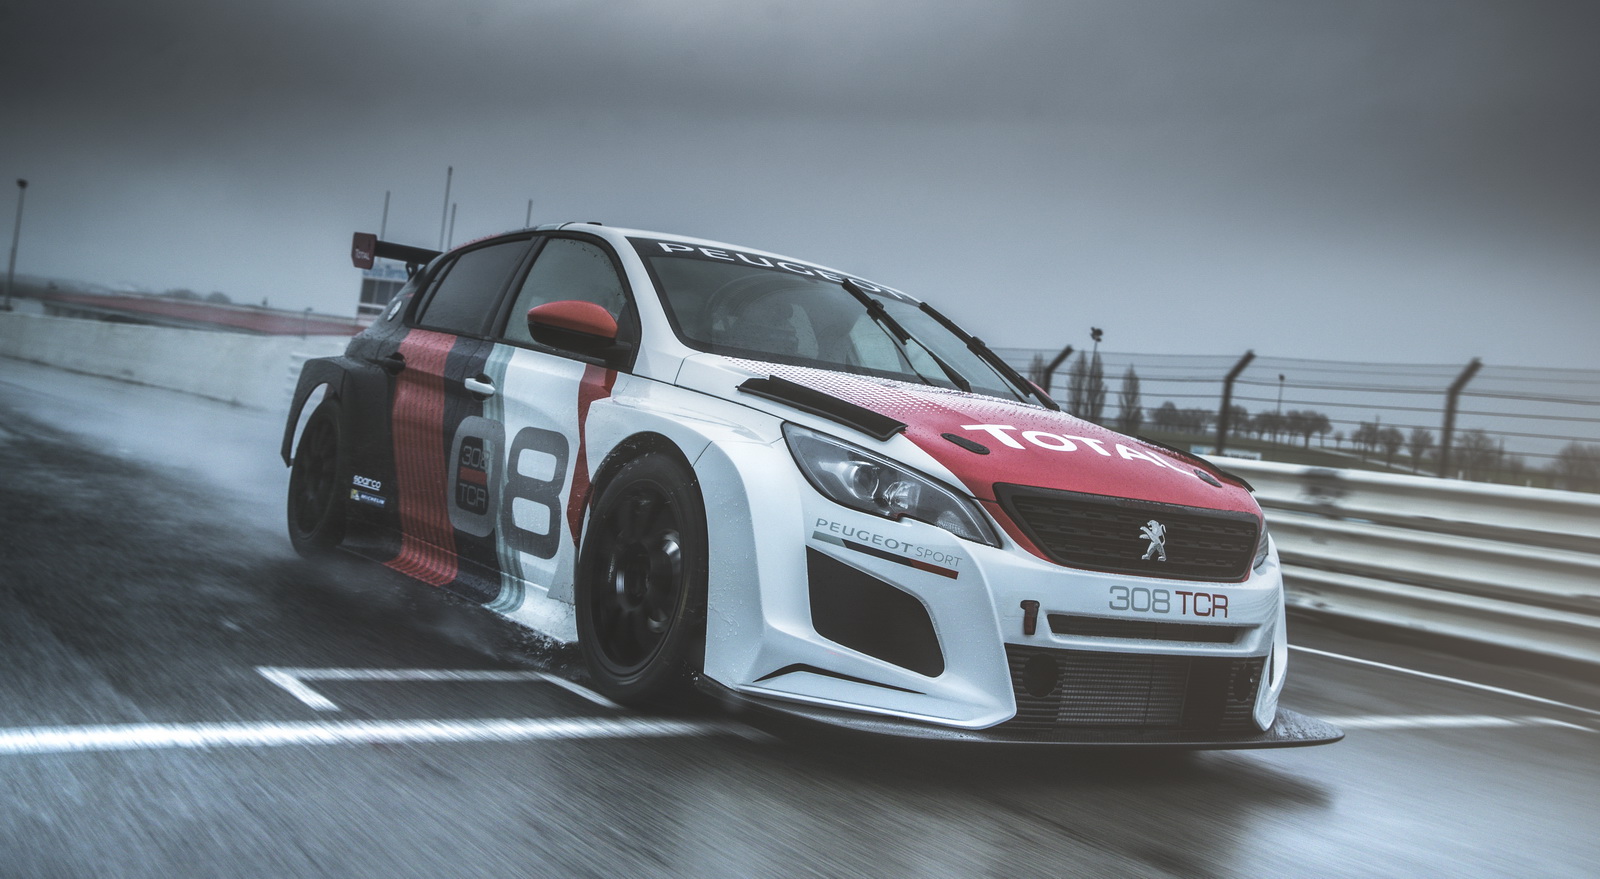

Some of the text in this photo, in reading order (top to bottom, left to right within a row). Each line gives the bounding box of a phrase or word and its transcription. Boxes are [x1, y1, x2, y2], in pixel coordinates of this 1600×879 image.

[355, 248, 371, 261] TOTAL
[657, 242, 903, 300] PEUGEOT
[461, 445, 491, 471] 308
[960, 424, 1198, 478] TOTAL
[353, 475, 382, 490] sparco
[447, 415, 570, 560] 08
[459, 483, 487, 509] TCR
[360, 494, 386, 505] MICHELIN
[815, 518, 963, 567] PEUGEOT SPORT
[1109, 585, 1229, 618] 308 TCR
